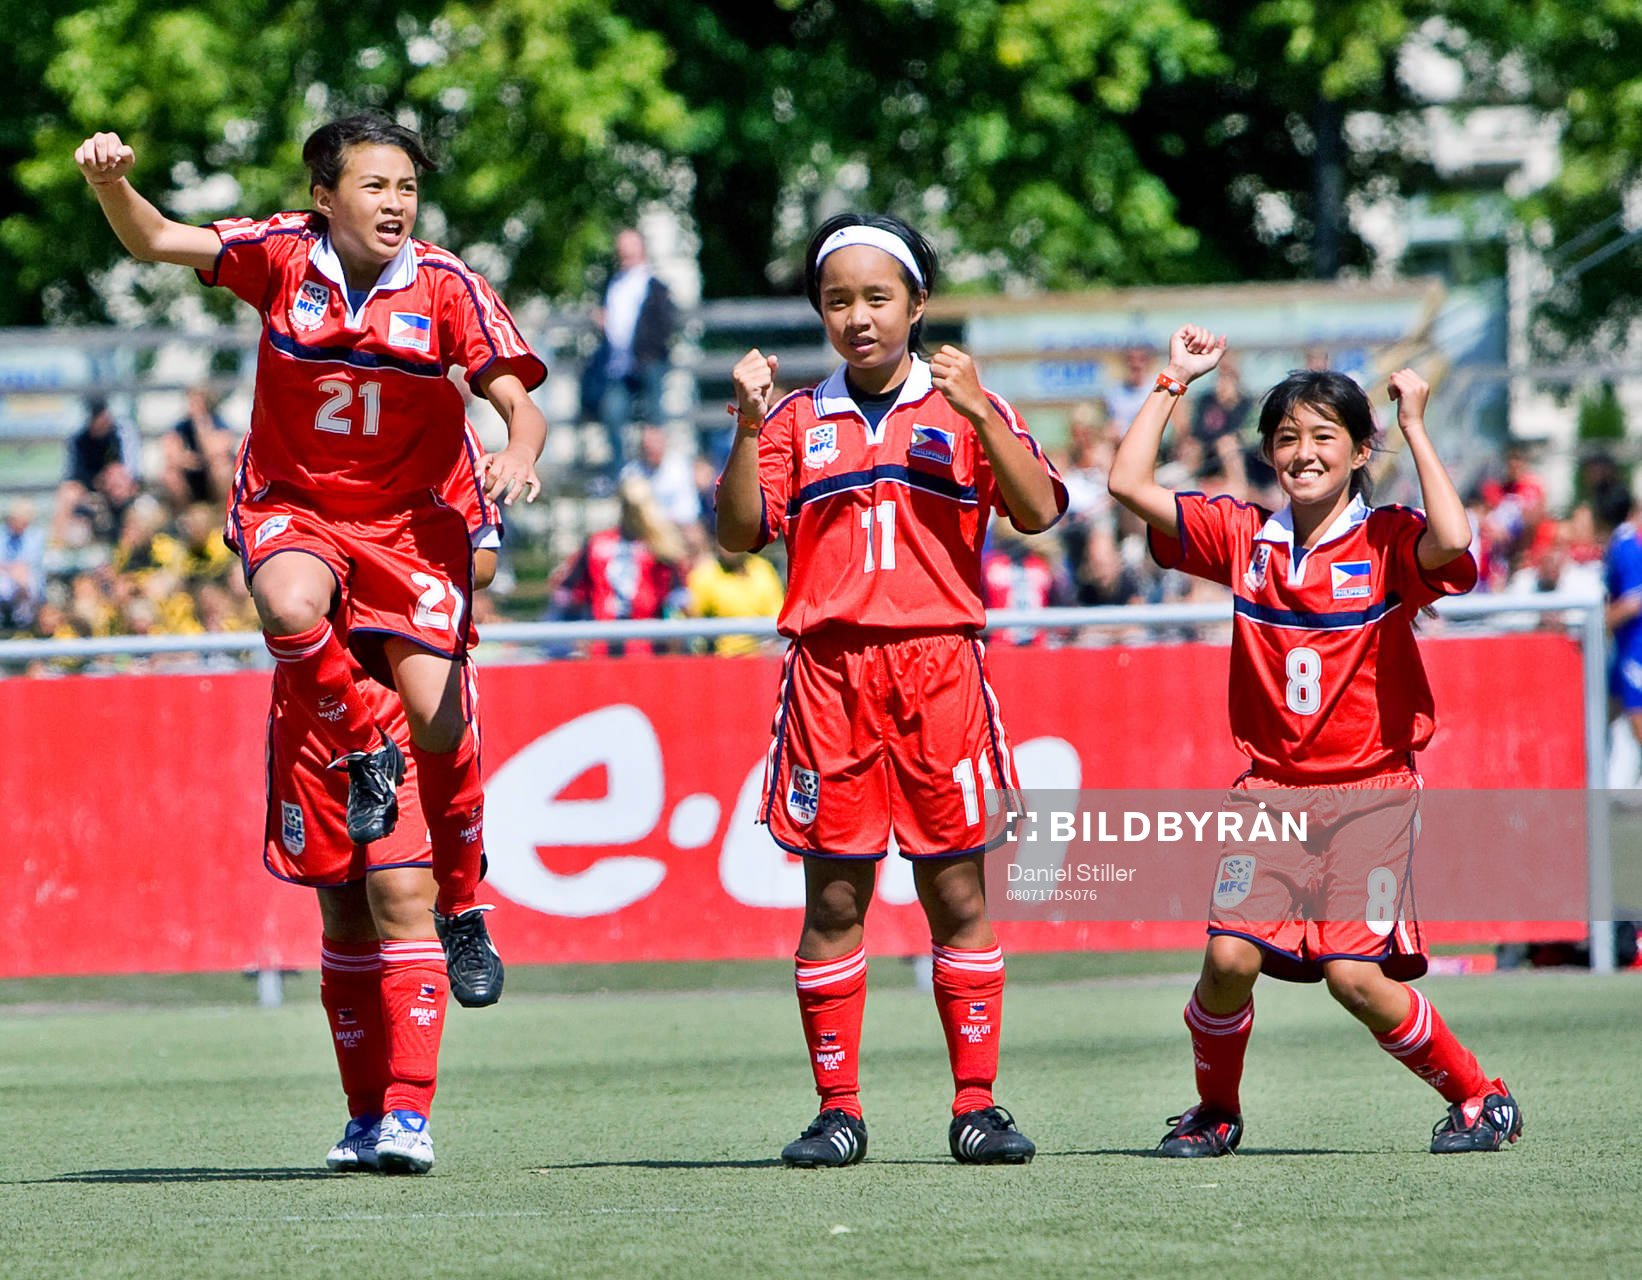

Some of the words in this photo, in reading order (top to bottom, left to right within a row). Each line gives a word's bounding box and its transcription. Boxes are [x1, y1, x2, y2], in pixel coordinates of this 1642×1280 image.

[296, 299, 324, 317] MFC
[315, 380, 381, 435] 21
[809, 440, 834, 454] MFC
[861, 501, 896, 574] 11
[1285, 647, 1322, 715] 8
[952, 748, 1000, 827] 11
[790, 790, 818, 812] MFC
[459, 821, 483, 838] MAKA
[1217, 880, 1249, 894] MFC
[1366, 867, 1397, 936] 8
[335, 1029, 365, 1040] MAKATI
[960, 1024, 991, 1035] MAKATI
